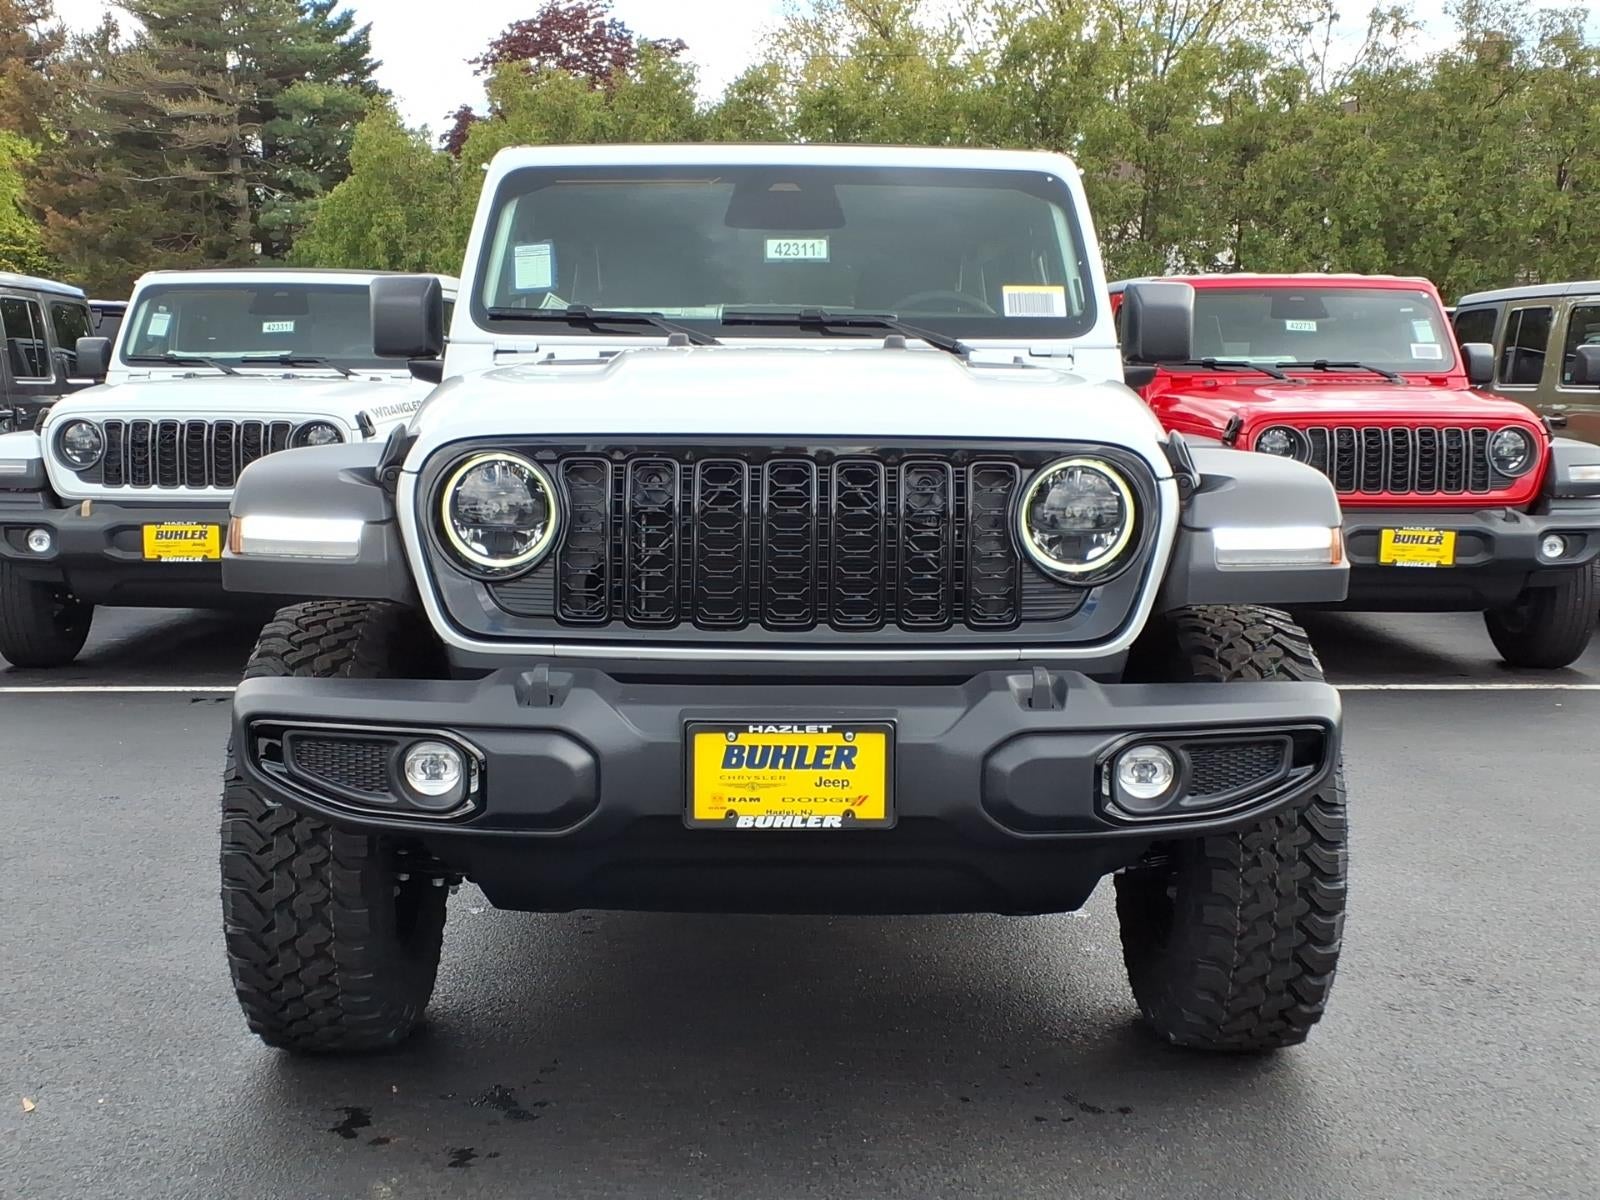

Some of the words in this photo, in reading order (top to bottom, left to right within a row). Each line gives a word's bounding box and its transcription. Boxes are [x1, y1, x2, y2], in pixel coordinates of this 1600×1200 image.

[774, 242, 815, 256] 42311
[155, 530, 208, 540] BUHLER
[1392, 534, 1444, 545] BUHLER
[748, 725, 832, 734] HAZLET
[722, 744, 858, 770] BUHLER
[814, 776, 850, 789] Jeep
[736, 815, 842, 828] BUHLER
